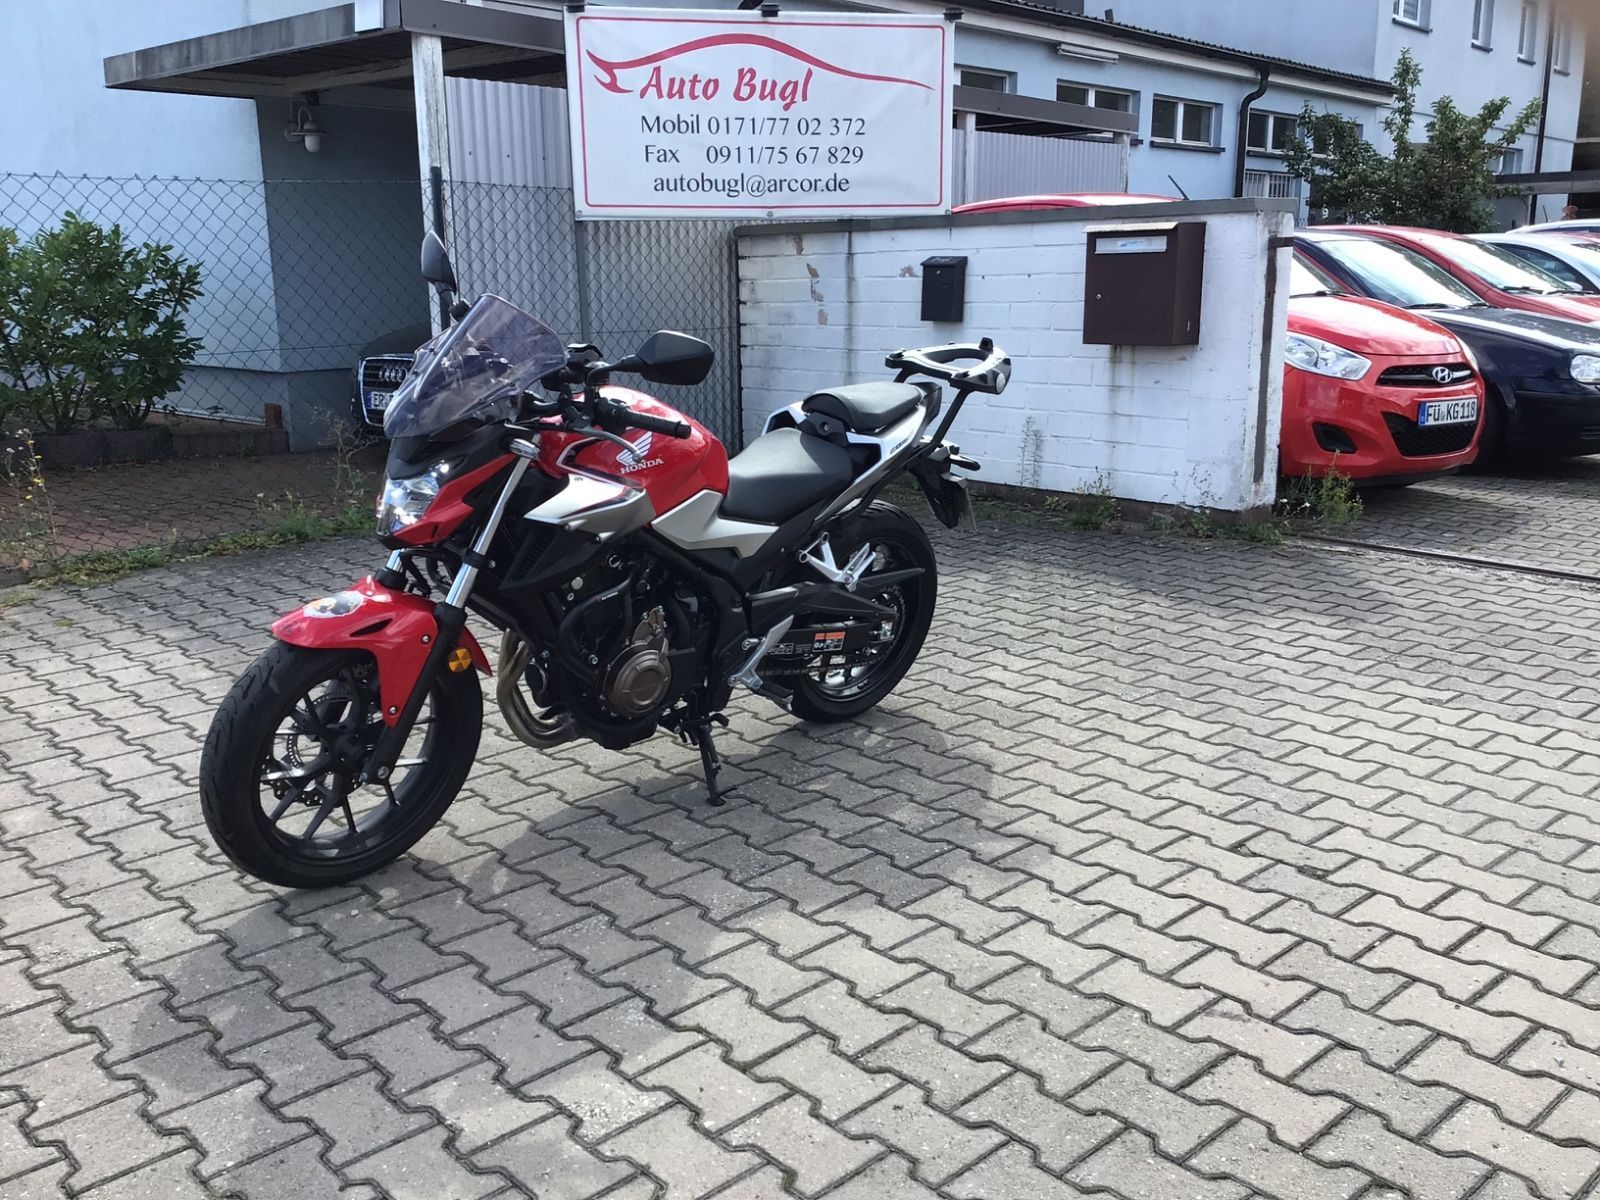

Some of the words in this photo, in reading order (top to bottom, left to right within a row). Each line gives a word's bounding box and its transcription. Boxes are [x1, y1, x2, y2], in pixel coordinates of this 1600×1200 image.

[639, 65, 720, 101] Auto
[732, 66, 814, 112] Bugl
[641, 114, 700, 136] Mobil
[707, 116, 790, 136] 0171/77
[797, 116, 822, 136] 02
[829, 116, 867, 136] 372
[644, 144, 681, 164] Fax
[705, 145, 788, 165] 0911/75
[795, 145, 821, 165] 67
[827, 145, 865, 165] 829
[653, 172, 851, 198] autobugl@arcor.de
[620, 457, 665, 475] HONDA
